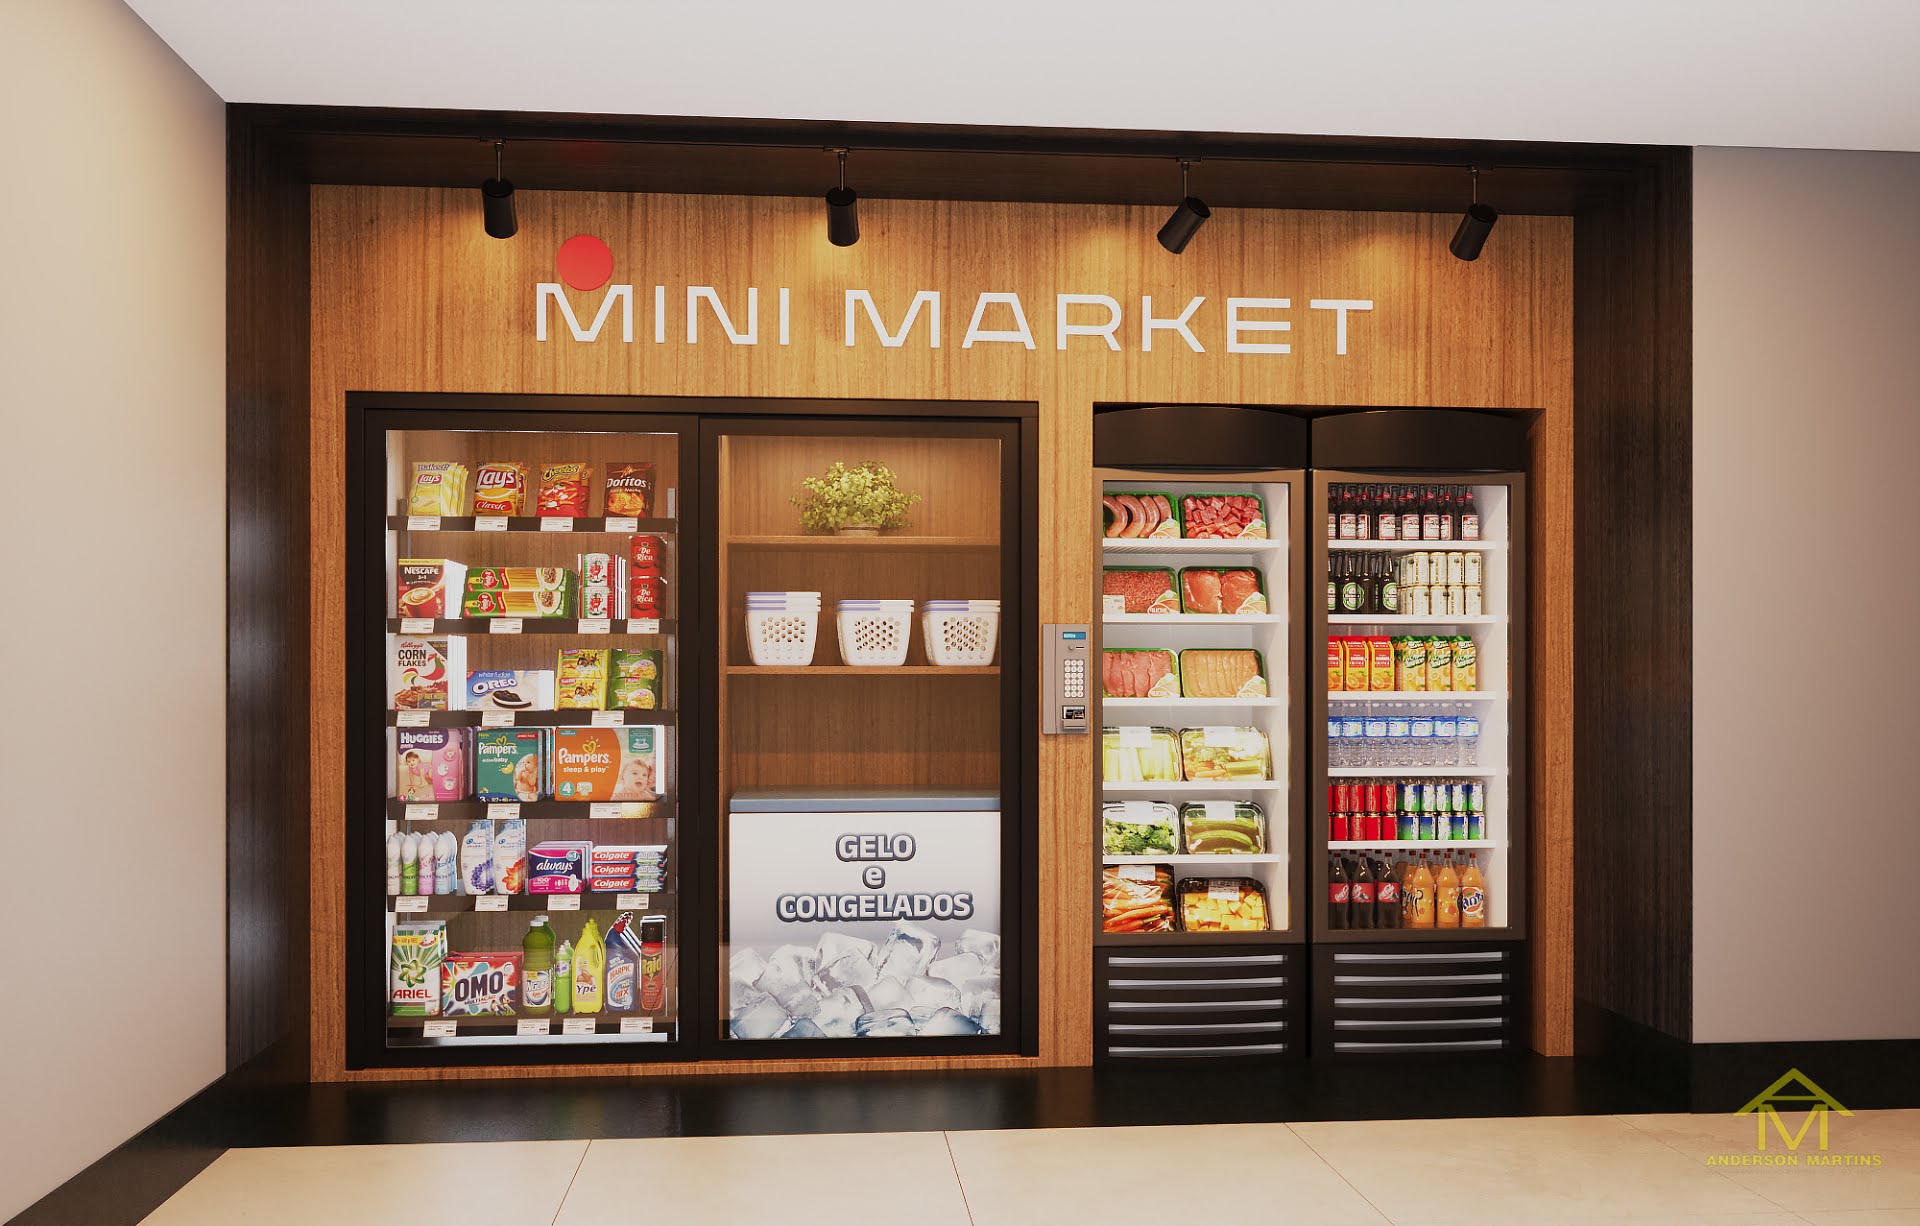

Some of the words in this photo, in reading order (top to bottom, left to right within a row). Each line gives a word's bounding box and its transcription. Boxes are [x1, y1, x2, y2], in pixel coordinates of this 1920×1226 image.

[536, 283, 790, 345] MINI
[845, 289, 1374, 355] MARKET
[606, 476, 647, 488] Doritos
[398, 649, 427, 660] CORN
[472, 678, 517, 694] OREO
[478, 741, 518, 758] Pampers
[558, 747, 610, 767] Pampers
[563, 766, 583, 774] sleep
[836, 833, 916, 861] GELO
[593, 852, 631, 861] Colgate
[536, 859, 575, 875] always
[593, 865, 631, 875] Colgate
[593, 879, 631, 889] Colgate
[863, 865, 885, 888] e
[777, 892, 973, 921] CONGELADOS
[393, 989, 433, 999] ARIEL
[455, 970, 504, 1002] OMO
